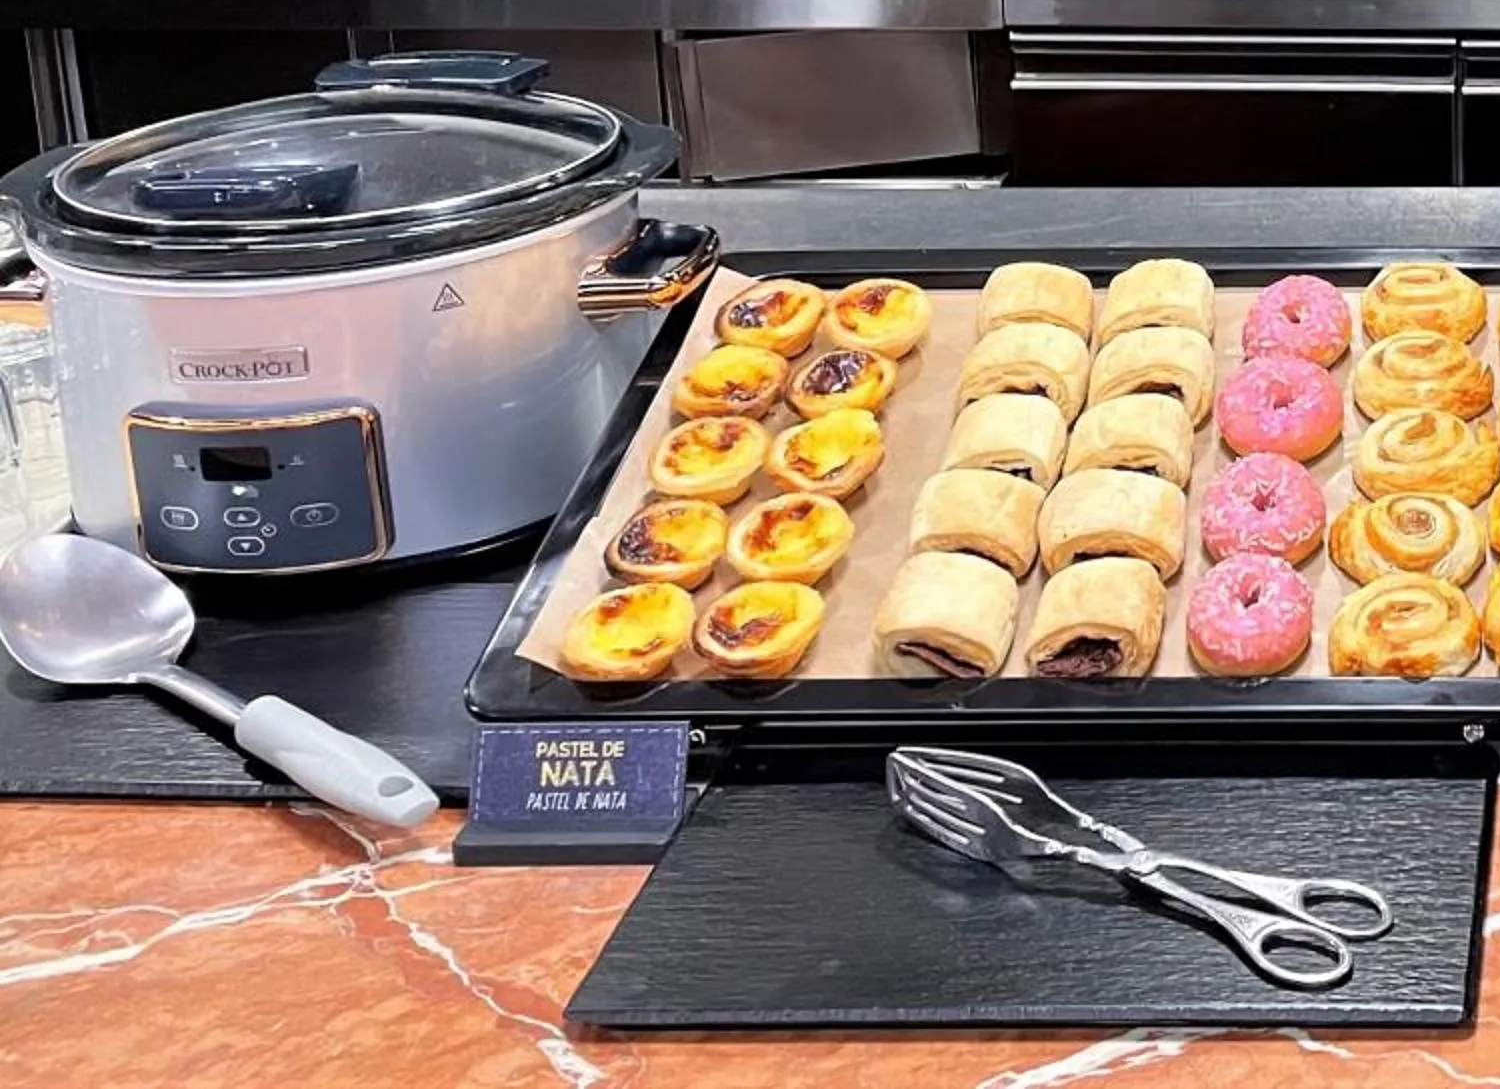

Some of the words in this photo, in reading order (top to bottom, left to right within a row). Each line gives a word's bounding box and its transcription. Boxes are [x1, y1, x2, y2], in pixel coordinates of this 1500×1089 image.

[535, 741, 598, 758] PASTEL
[602, 741, 625, 757] DE
[539, 761, 616, 787] NATA
[526, 793, 570, 811] PASTEL
[575, 793, 589, 810] DE
[592, 792, 627, 810] NATA
